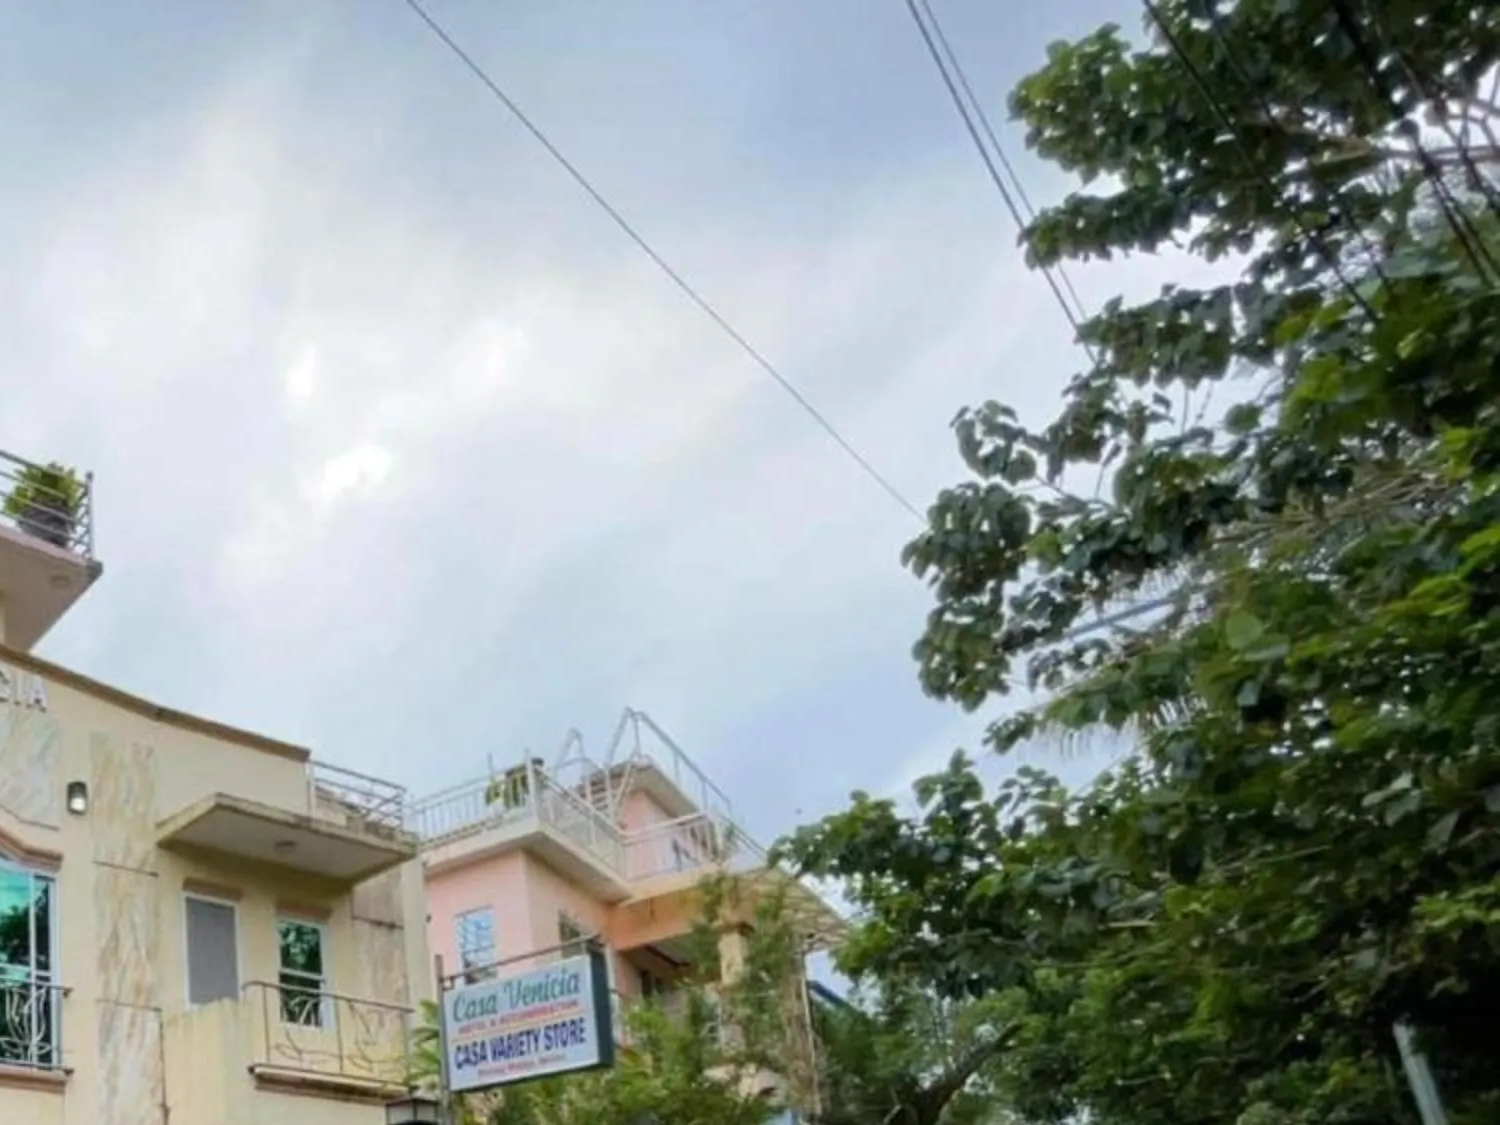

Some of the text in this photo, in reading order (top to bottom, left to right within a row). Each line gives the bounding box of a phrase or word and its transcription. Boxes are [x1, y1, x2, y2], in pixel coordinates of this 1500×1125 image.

[454, 991, 498, 1022] Casa
[503, 967, 580, 1009] Venicia
[456, 1040, 488, 1069] CASA
[490, 1028, 541, 1061] VARIETY
[544, 1017, 586, 1050] STORE
